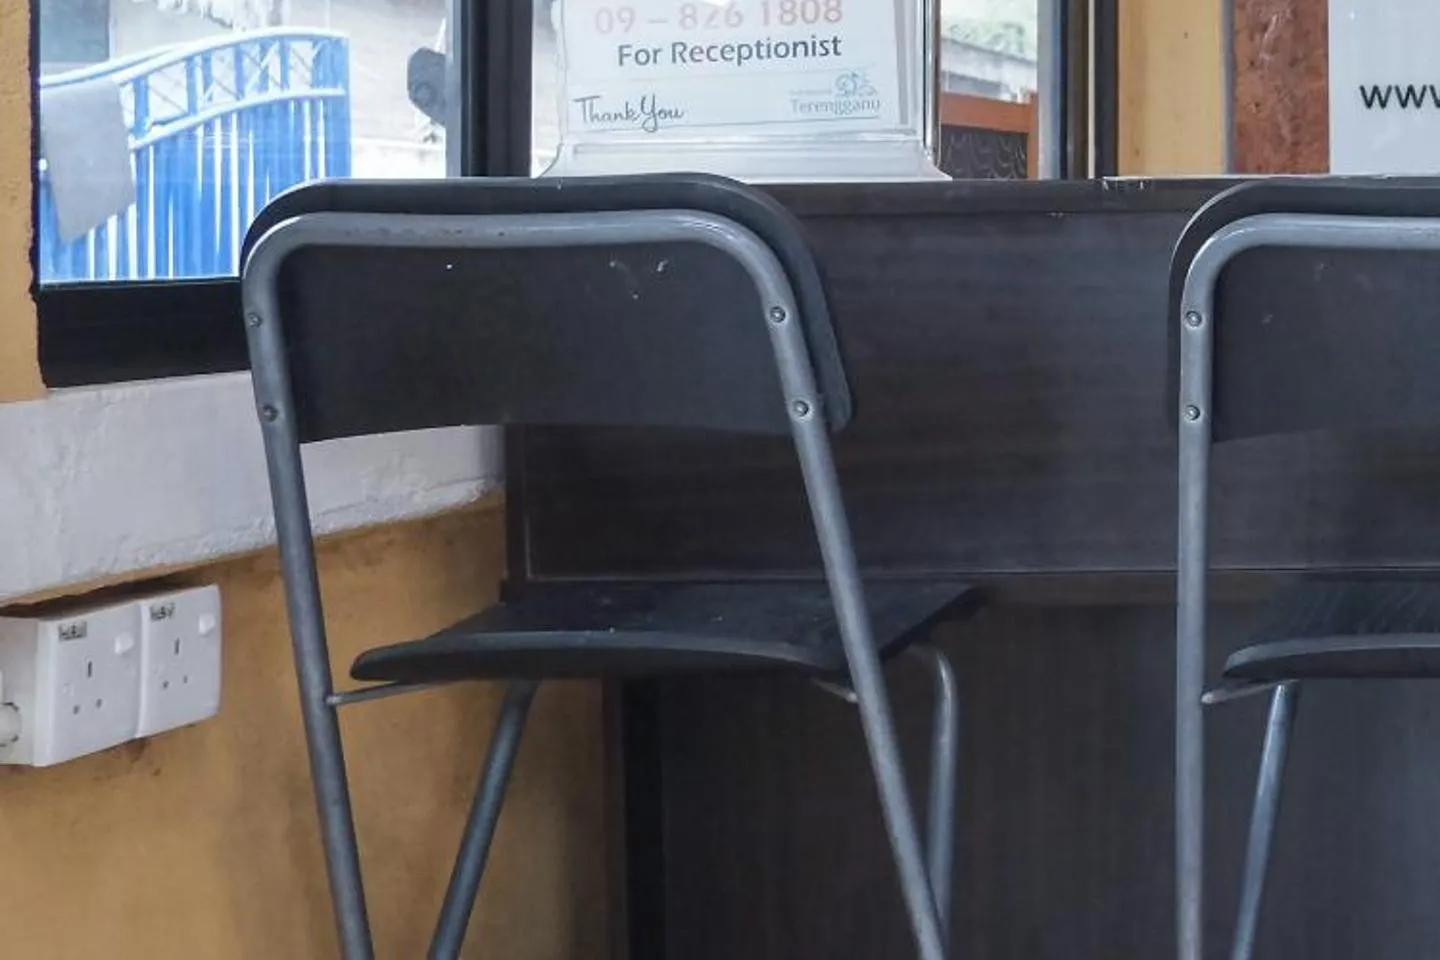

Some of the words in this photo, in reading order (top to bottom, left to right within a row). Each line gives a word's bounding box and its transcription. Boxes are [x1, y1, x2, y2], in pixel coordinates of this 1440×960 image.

[594, 6, 637, 35] 09
[678, 0, 744, 30] 826
[618, 43, 662, 67] For
[671, 34, 842, 66] Receptionist
